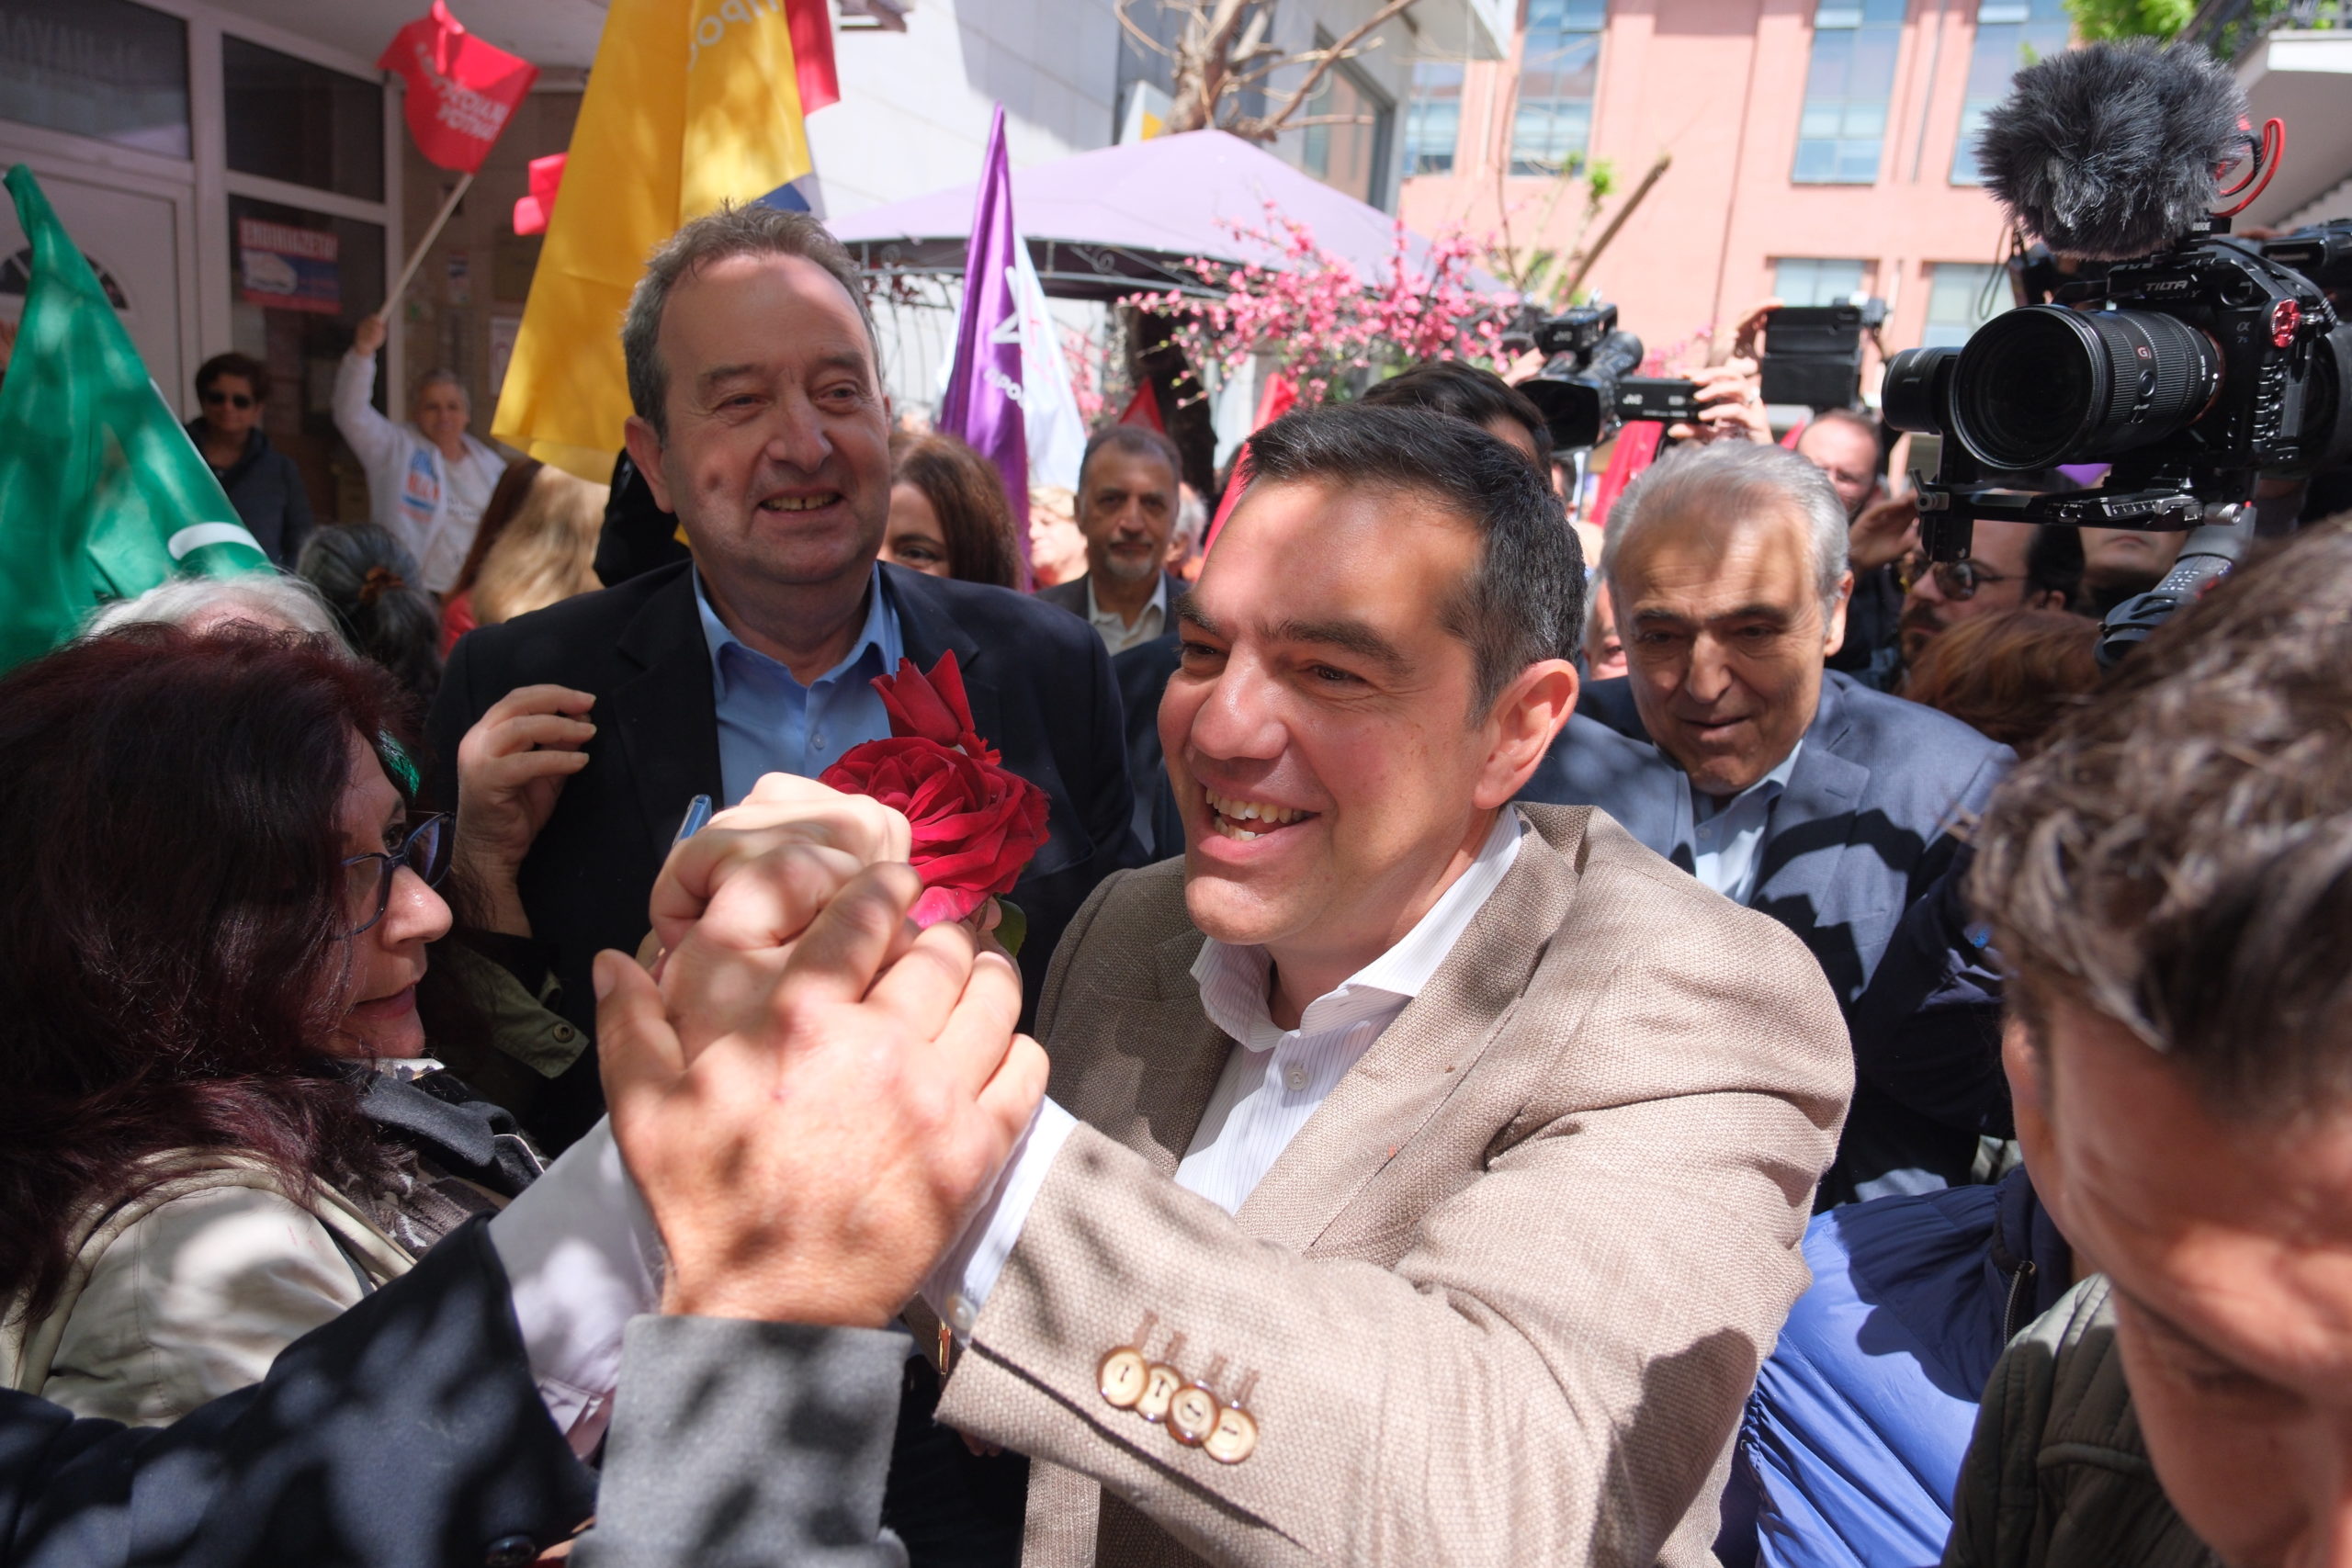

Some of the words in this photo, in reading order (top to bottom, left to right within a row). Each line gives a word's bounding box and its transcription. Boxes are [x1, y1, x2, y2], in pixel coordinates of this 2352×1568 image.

[2145, 279, 2188, 292] TILTA
[1553, 331, 1573, 343] JVC
[1623, 393, 1644, 405] JVC
